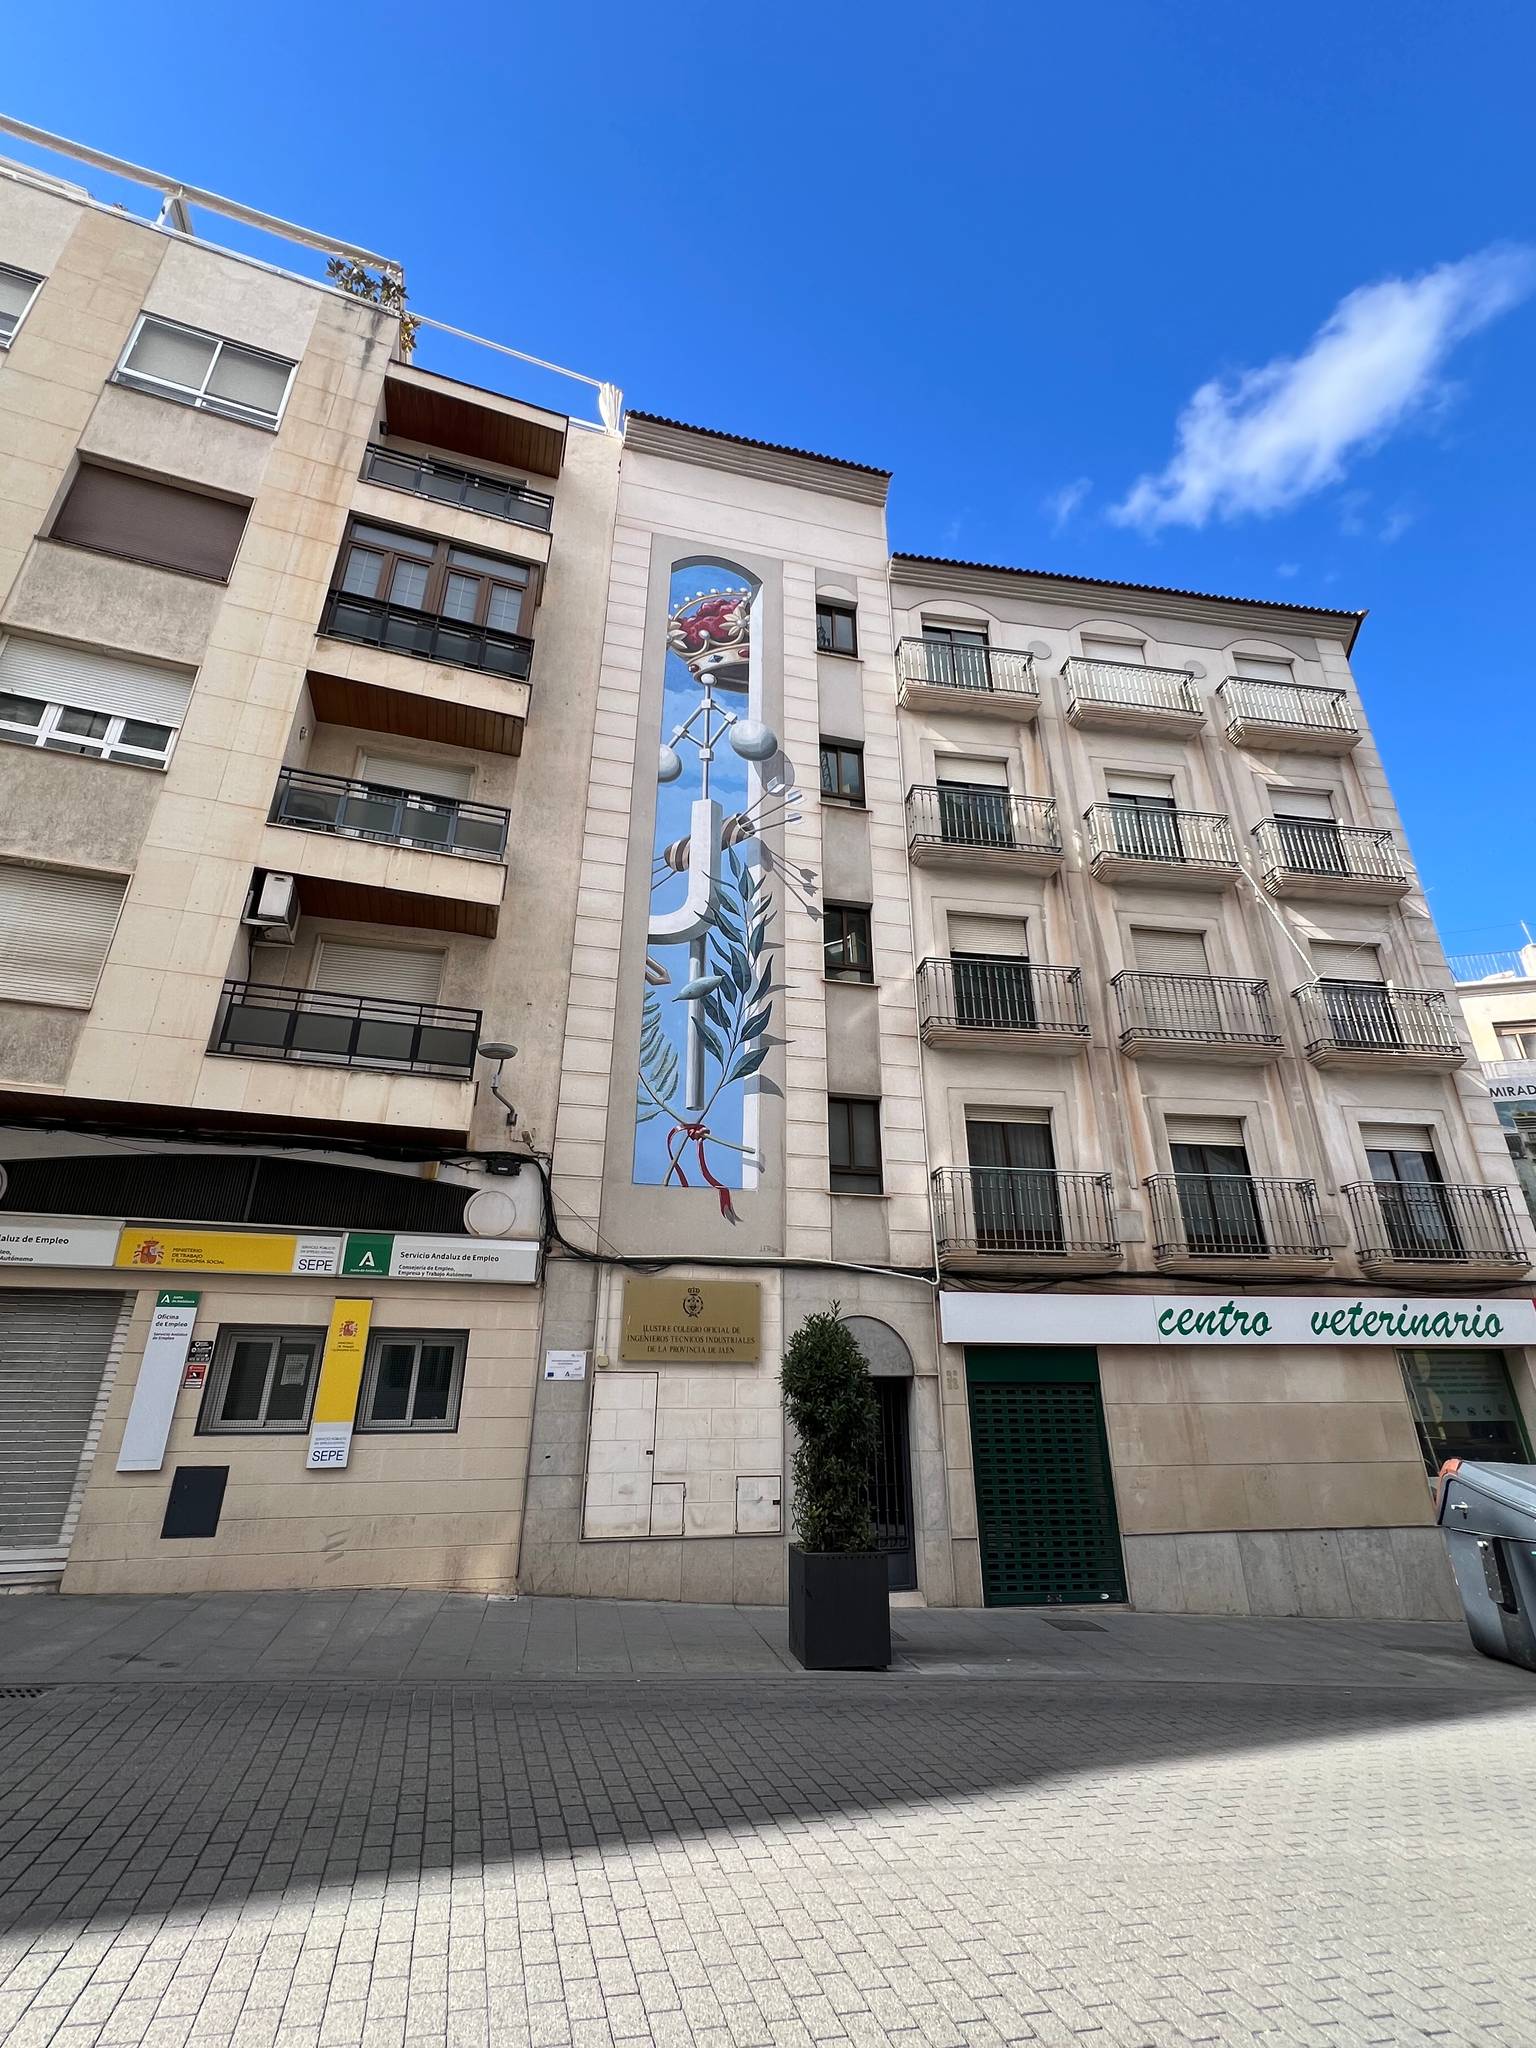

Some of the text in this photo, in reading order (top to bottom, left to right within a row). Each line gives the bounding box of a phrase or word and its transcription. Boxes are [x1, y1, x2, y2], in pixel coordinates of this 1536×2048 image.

[0, 1234, 20, 1242] aluz
[36, 1236, 69, 1245] Empleo
[400, 1252, 430, 1260] Servicio
[431, 1252, 460, 1260] Andaluz
[472, 1254, 500, 1263] Empleo
[298, 1258, 334, 1272] SEPE
[1158, 1301, 1504, 1338] centro veterinario
[643, 1325, 674, 1334] ILUSTRE
[674, 1326, 702, 1334] COLEGIO
[703, 1326, 730, 1334] OFICIAL
[627, 1334, 670, 1342] INGENIEROS
[706, 1336, 756, 1344] INDUSTRIALES
[312, 1450, 344, 1462] SEPE
